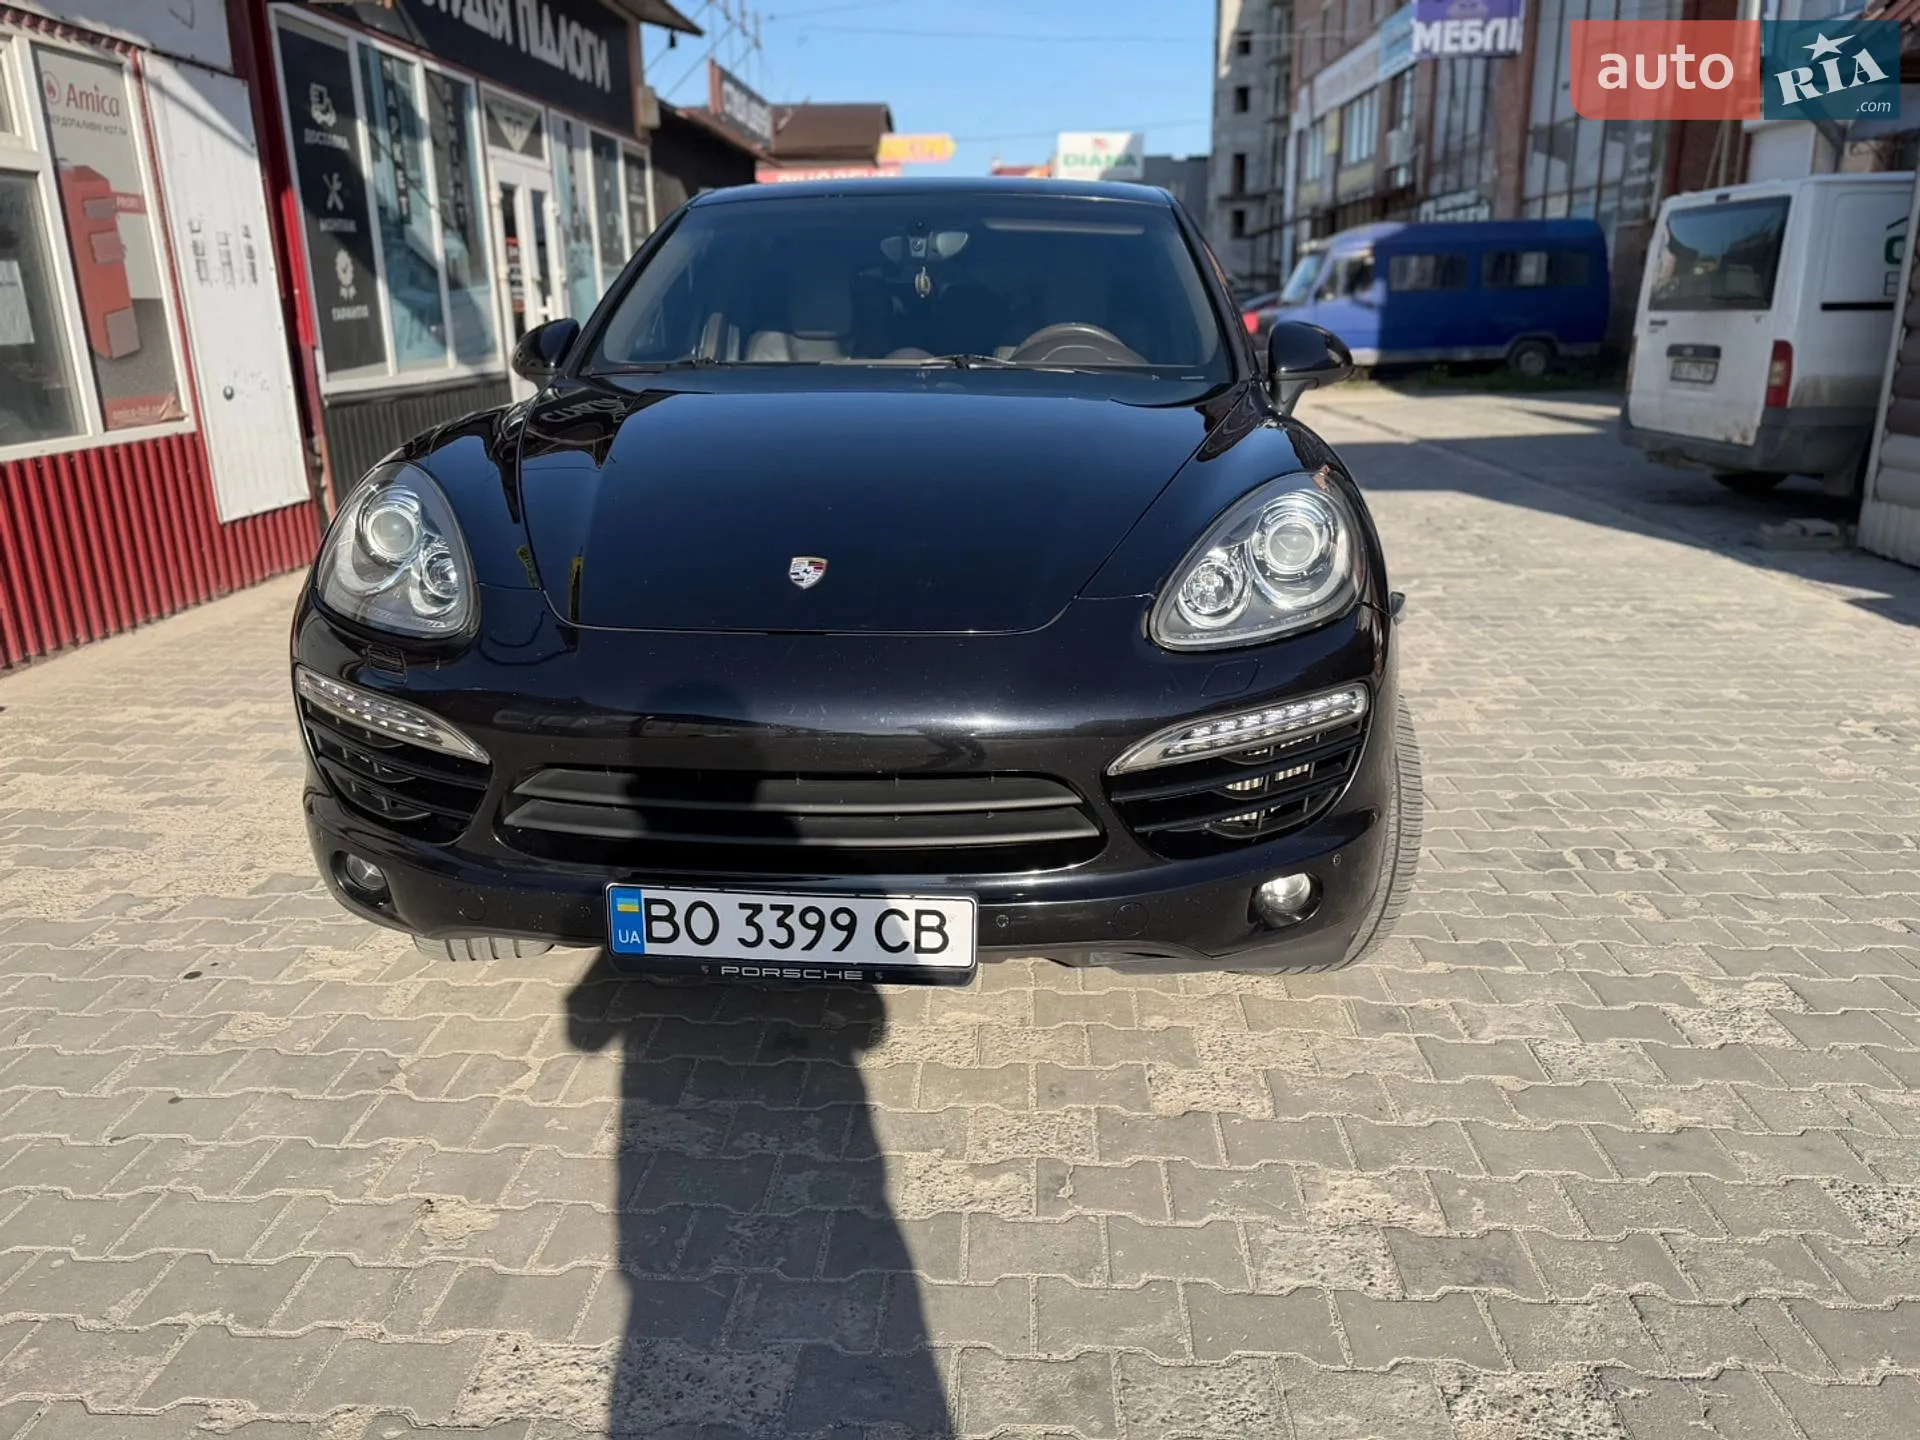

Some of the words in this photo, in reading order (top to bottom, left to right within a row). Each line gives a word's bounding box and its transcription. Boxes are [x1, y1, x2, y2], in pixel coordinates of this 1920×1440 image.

[1411, 17, 1523, 54] МЕБЛІ
[66, 83, 120, 117] Amica
[1063, 153, 1137, 168] DIANA
[618, 928, 641, 944] UA
[644, 897, 720, 946] BO
[737, 902, 858, 952] 3399
[874, 907, 950, 955] CB
[721, 965, 863, 980] PORSCHE
